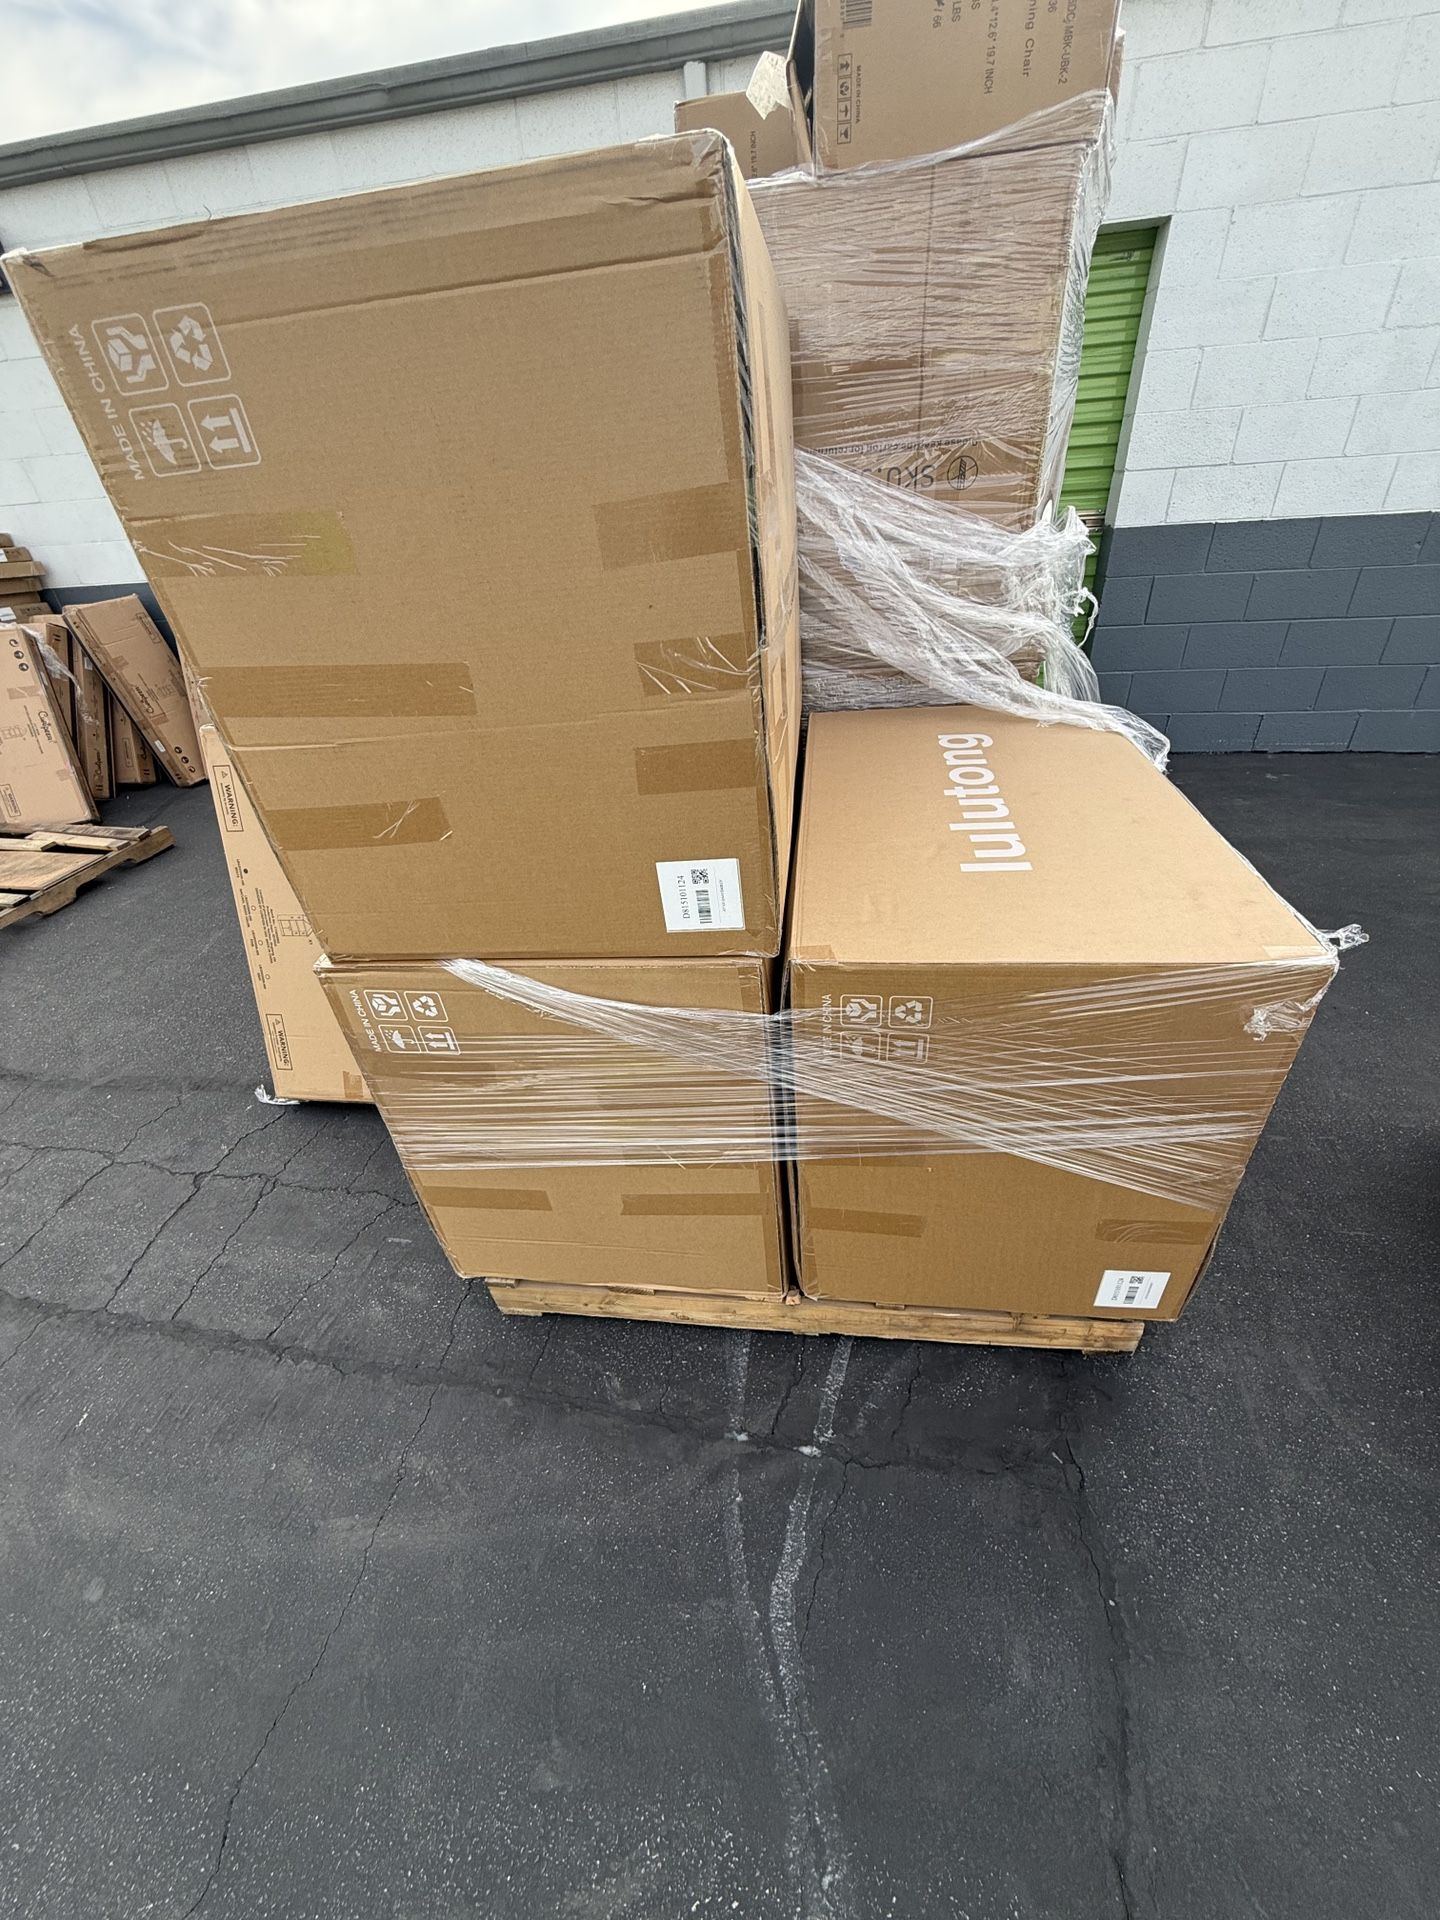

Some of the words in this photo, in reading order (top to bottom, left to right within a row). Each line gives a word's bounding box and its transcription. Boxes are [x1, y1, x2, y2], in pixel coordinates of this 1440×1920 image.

[951, 1, 962, 23] LBS
[1022, 38, 1035, 79] Chair
[983, 68, 995, 95] INCH
[68, 323, 106, 393] CHINA
[100, 396, 120, 421] IN
[112, 422, 145, 481] MADE
[937, 733, 1034, 873] lulutong
[349, 989, 367, 1016] CHINA
[361, 1016, 372, 1029] IN
[365, 1028, 382, 1053] MADE
